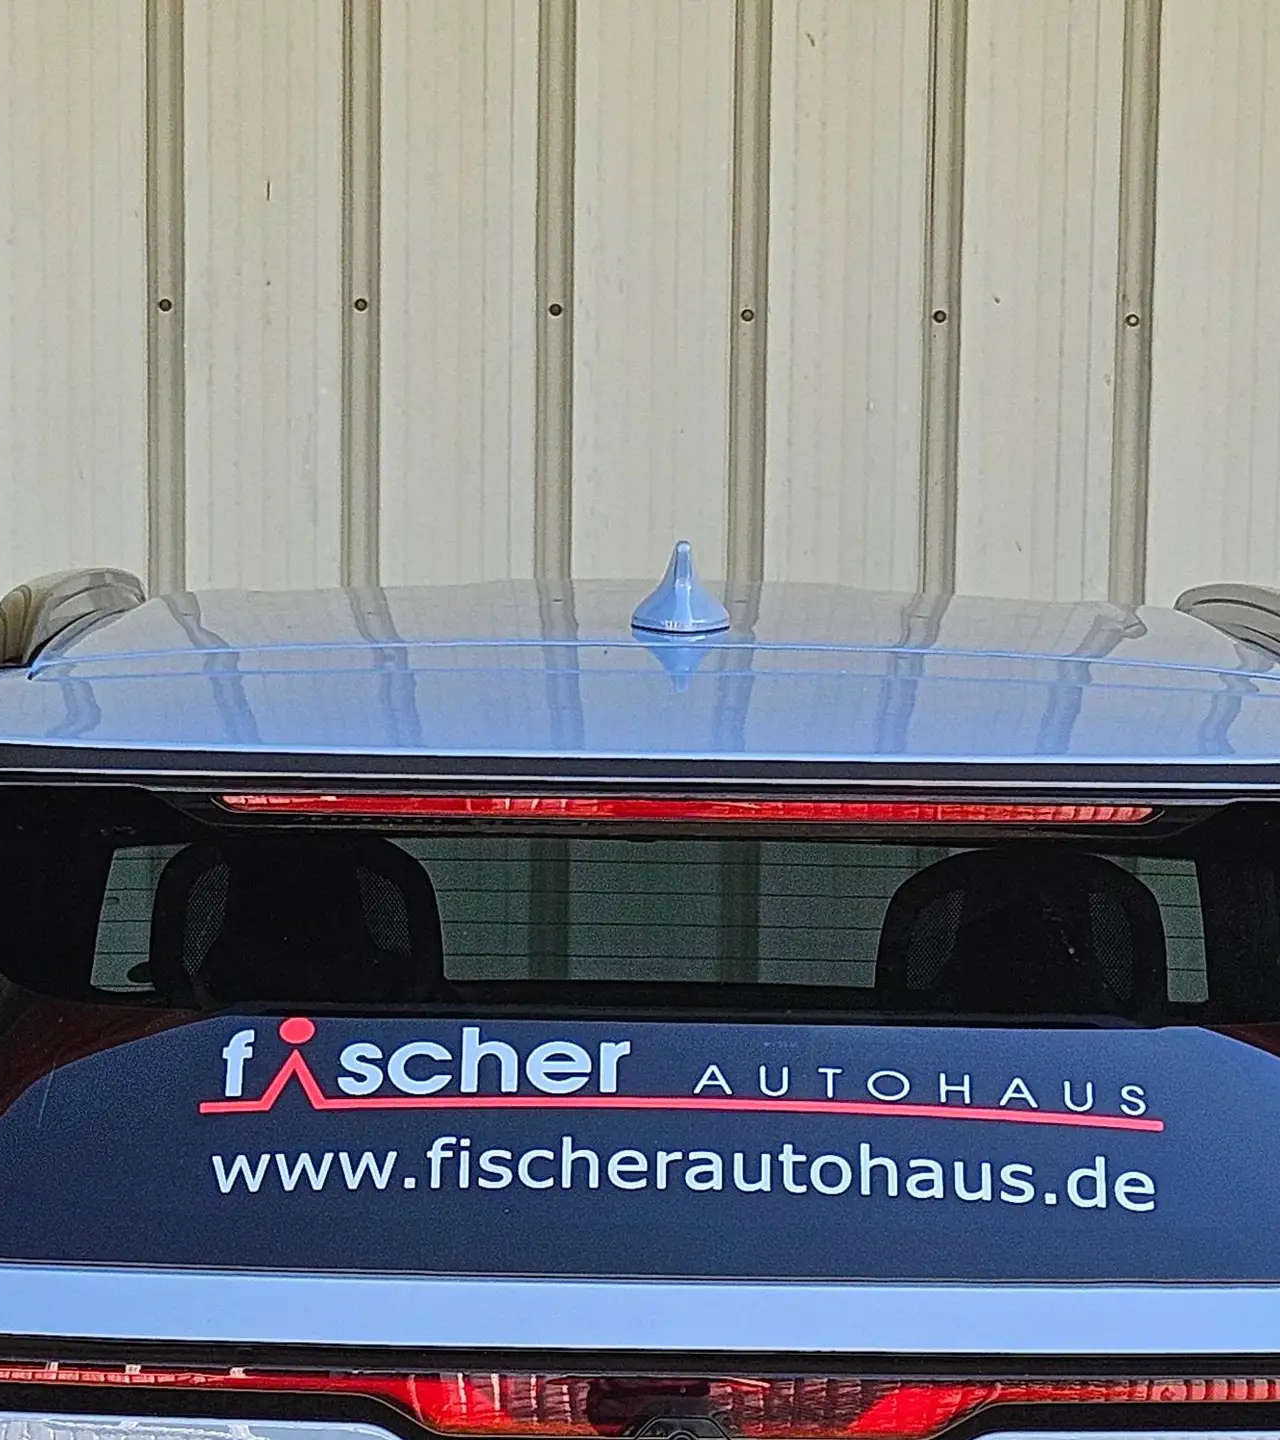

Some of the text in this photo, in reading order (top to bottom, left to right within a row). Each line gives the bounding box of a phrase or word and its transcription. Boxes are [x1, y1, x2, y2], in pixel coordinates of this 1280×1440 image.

[222, 1017, 1148, 1118] fischer AUTOHAUS
[211, 1136, 1156, 1212] www.fischerautohaus.de
